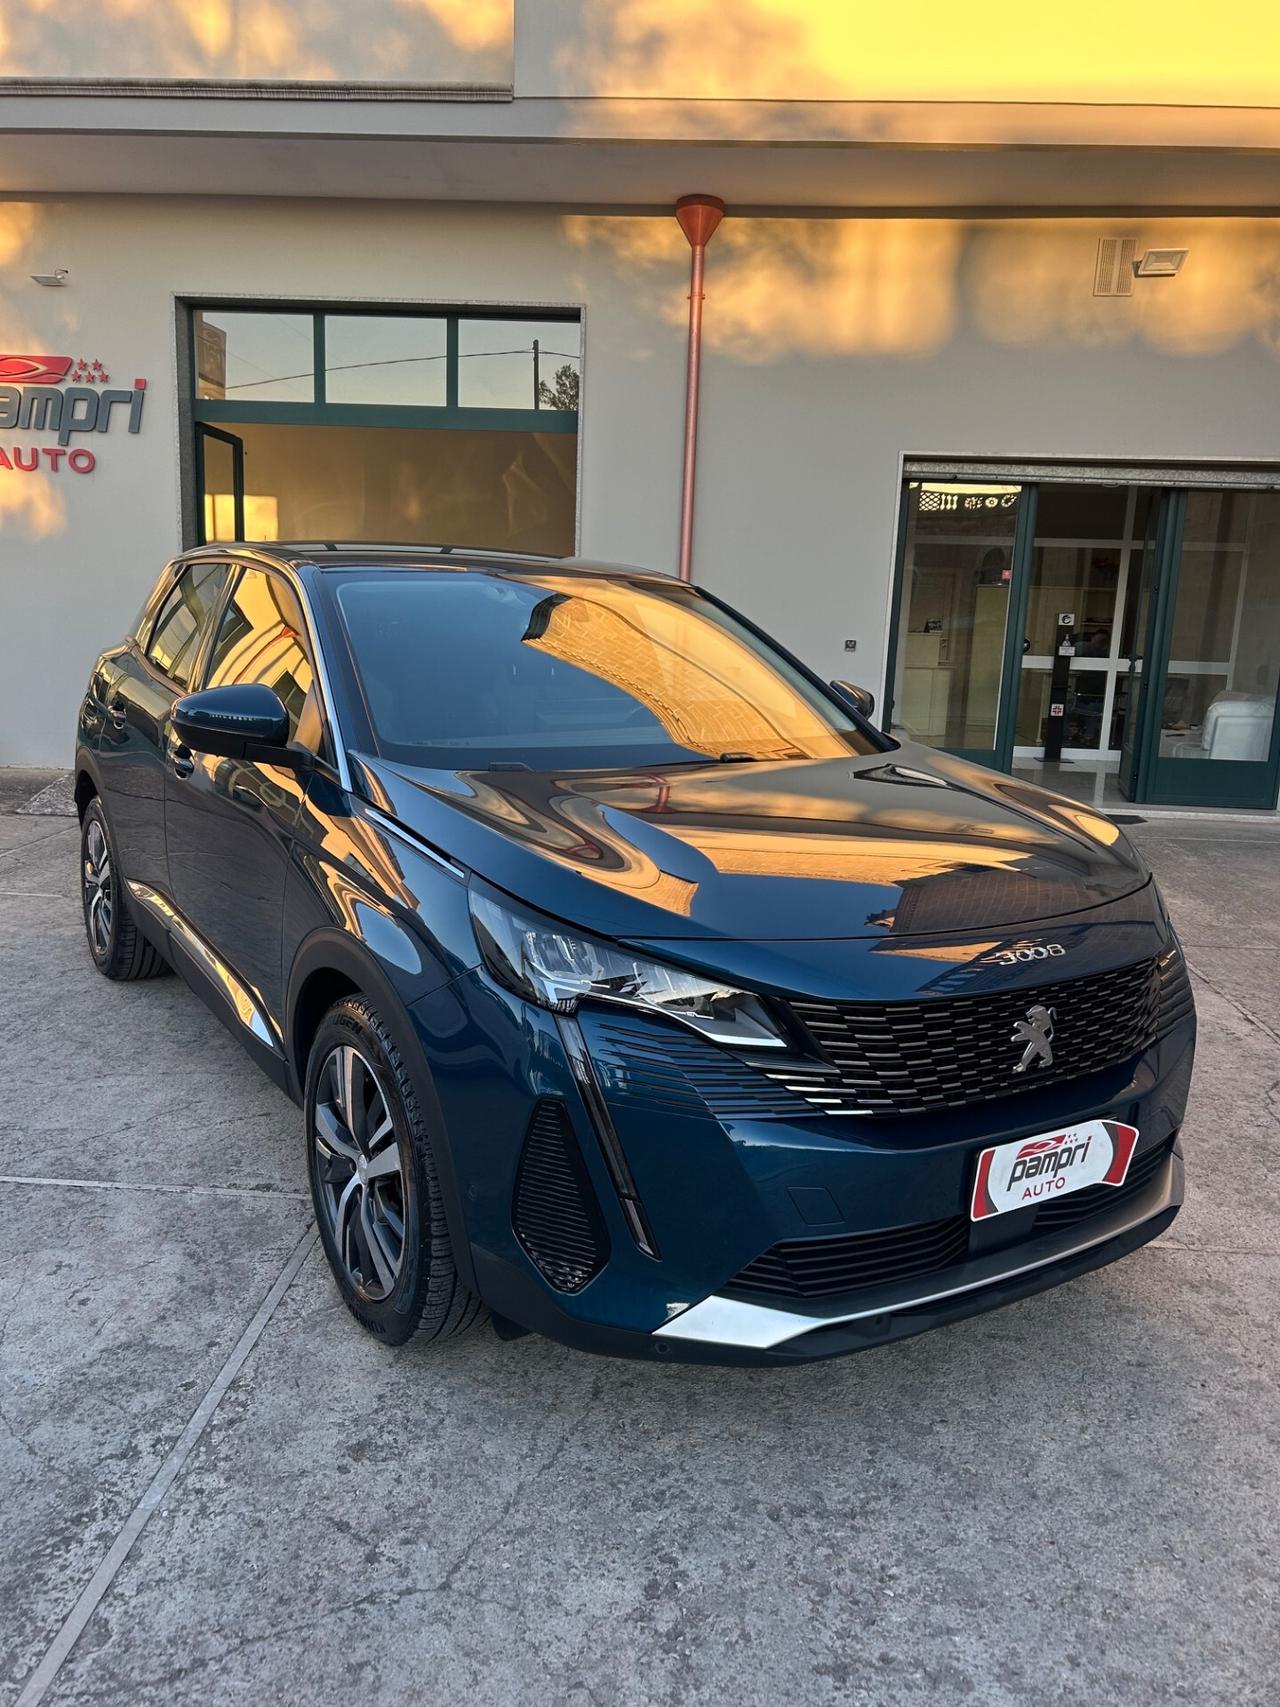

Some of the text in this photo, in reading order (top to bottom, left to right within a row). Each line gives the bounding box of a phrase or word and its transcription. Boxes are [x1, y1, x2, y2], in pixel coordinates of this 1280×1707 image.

[995, 943, 1067, 966] 3008
[1006, 1135, 1093, 1192] pampri
[1021, 1176, 1066, 1201] AUTO
